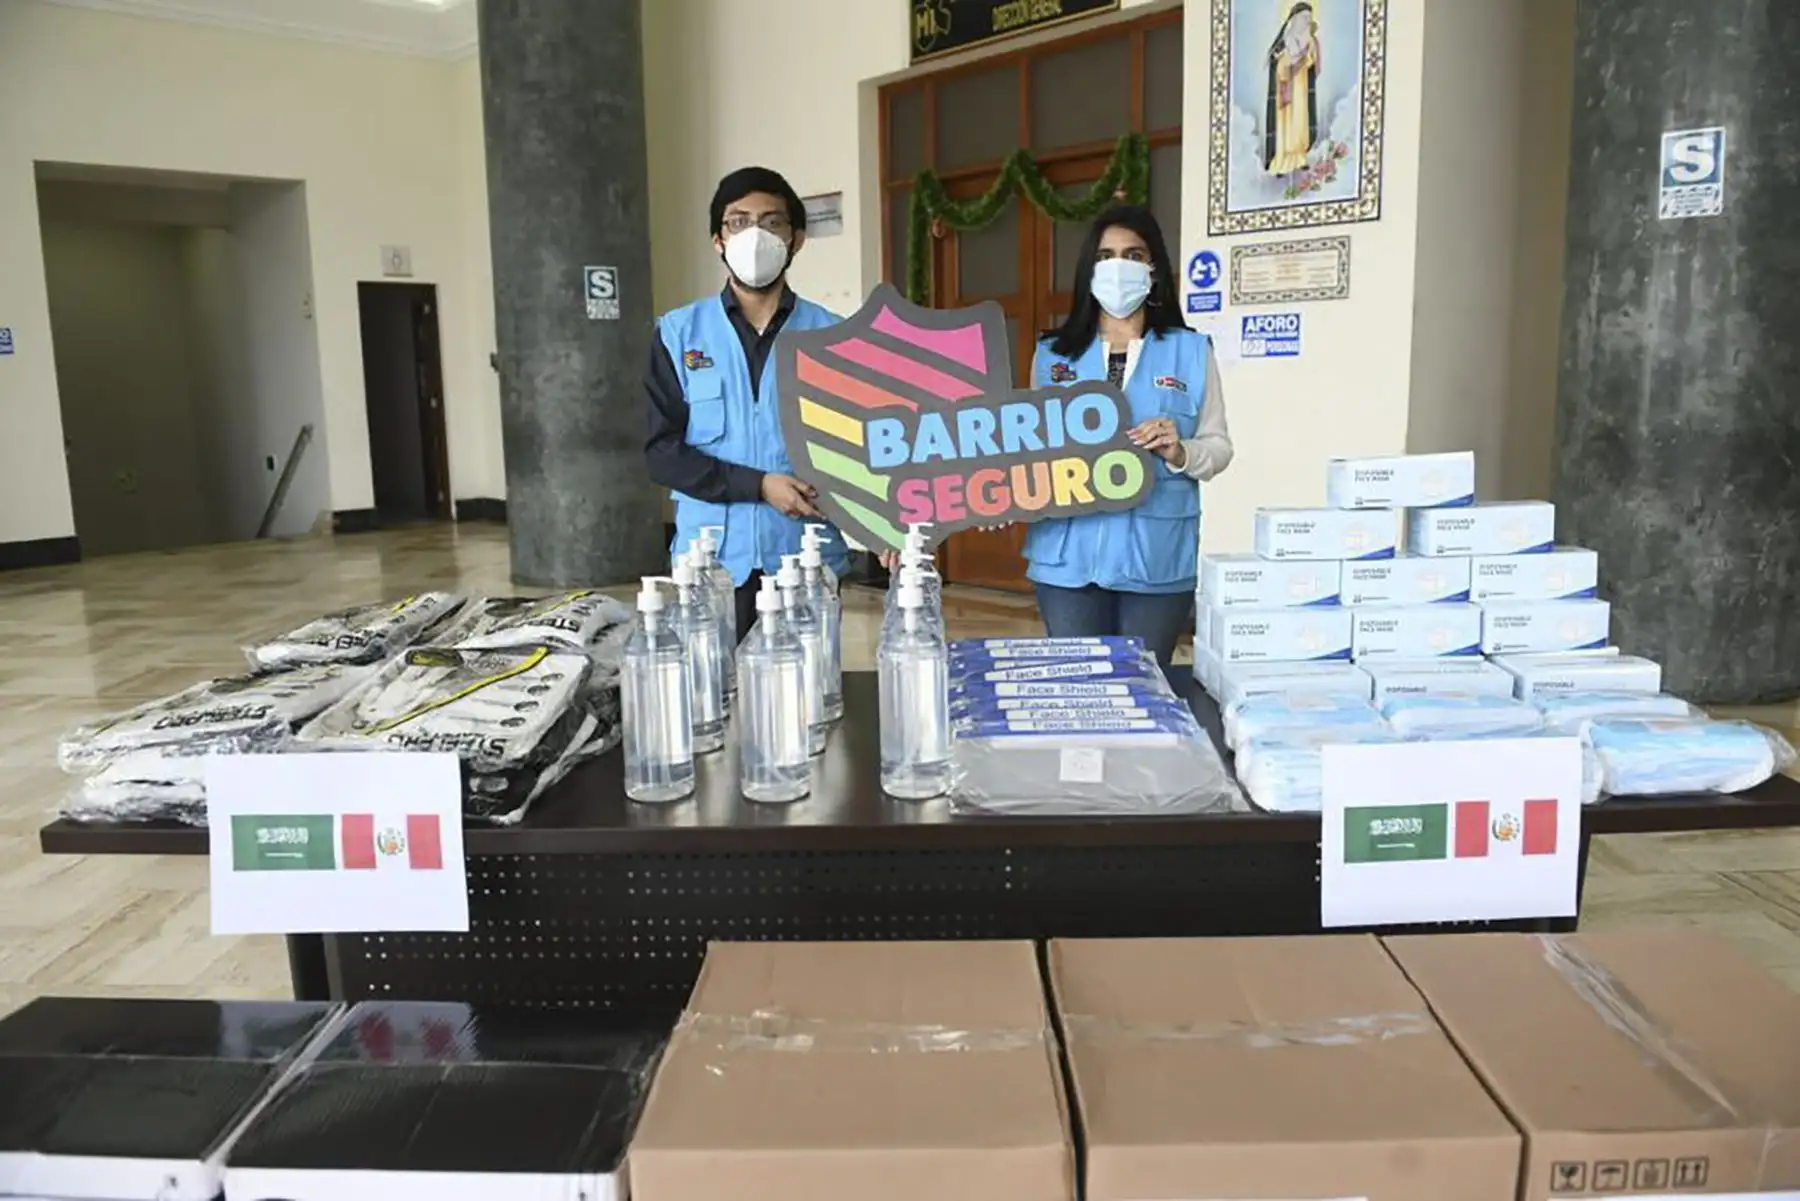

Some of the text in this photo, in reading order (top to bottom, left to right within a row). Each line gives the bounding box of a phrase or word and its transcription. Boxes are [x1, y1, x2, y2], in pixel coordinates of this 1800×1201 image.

[1669, 137, 1716, 182] S
[590, 271, 614, 298] S
[1245, 315, 1298, 332] AFORO
[867, 392, 1119, 469] BARRIO
[896, 450, 1145, 524] SEGURO
[1005, 664, 1093, 681] Face Shield
[1016, 684, 1108, 694] Face Shield
[1029, 709, 1126, 718] Face Shield
[1032, 721, 1132, 729] Face Shield
